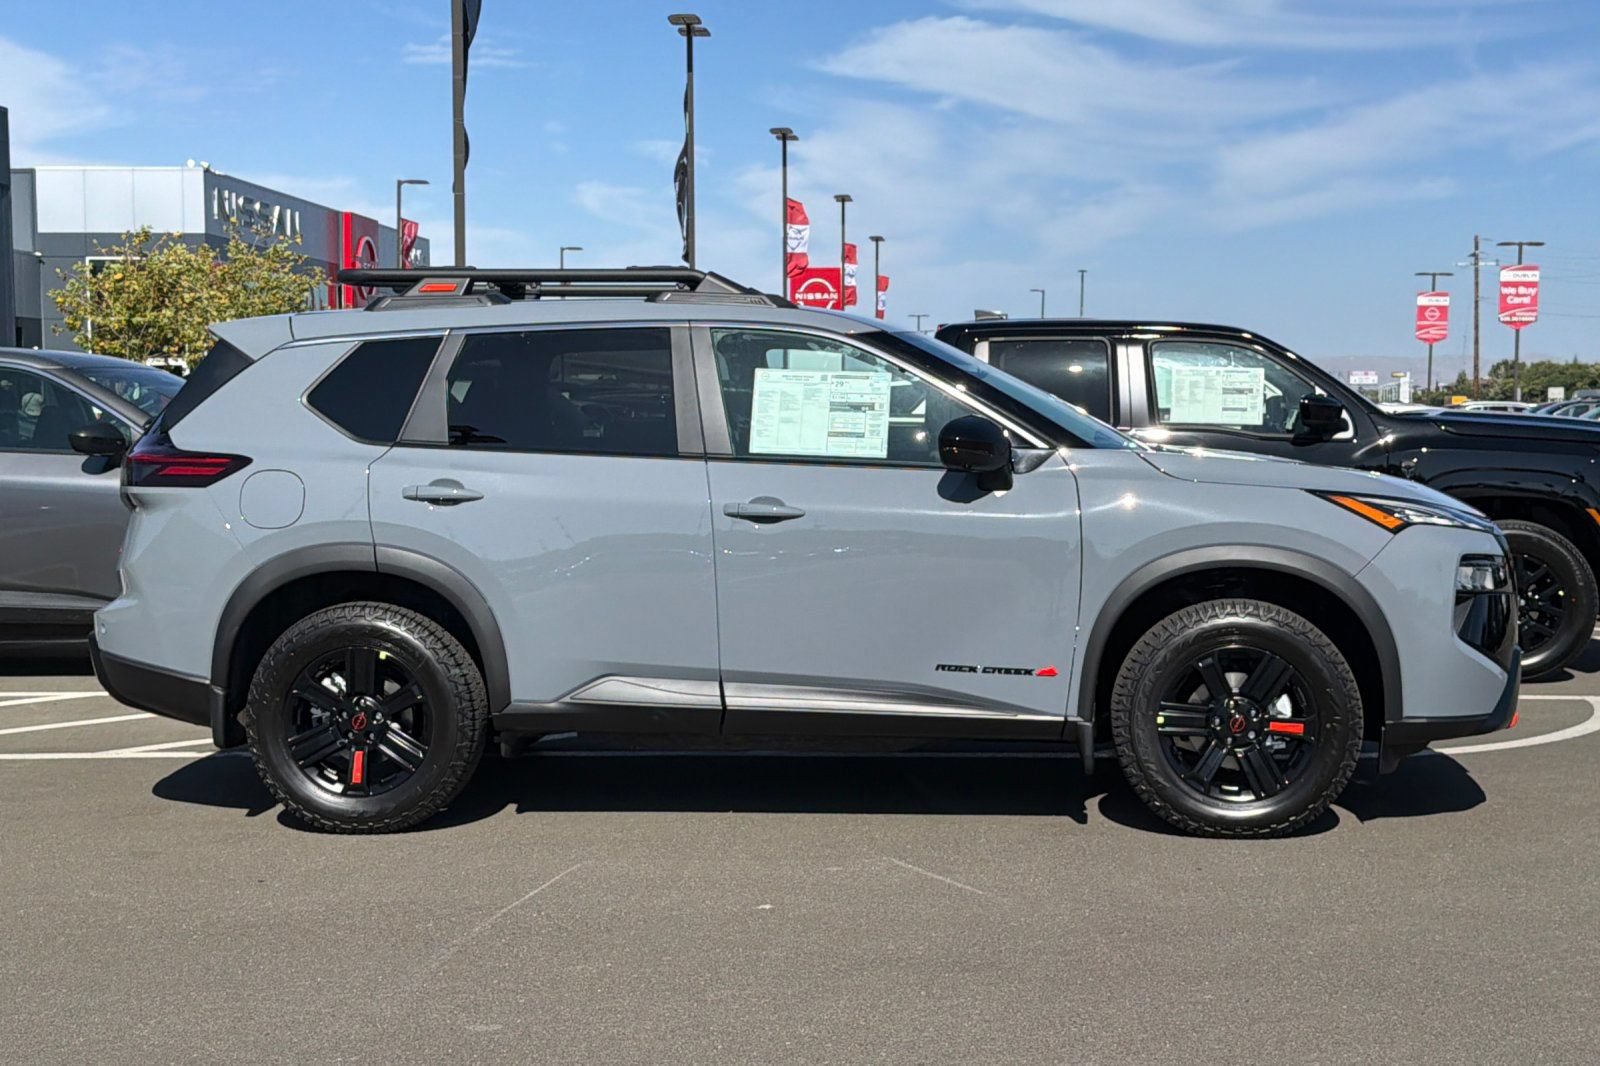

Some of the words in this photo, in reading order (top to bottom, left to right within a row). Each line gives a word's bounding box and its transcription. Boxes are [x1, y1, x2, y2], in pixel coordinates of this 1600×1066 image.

[795, 292, 838, 300] NISSAN
[1500, 286, 1517, 296] We
[1517, 285, 1538, 297] Buy
[935, 664, 978, 673] ROCK
[981, 666, 1035, 676] CREEK
